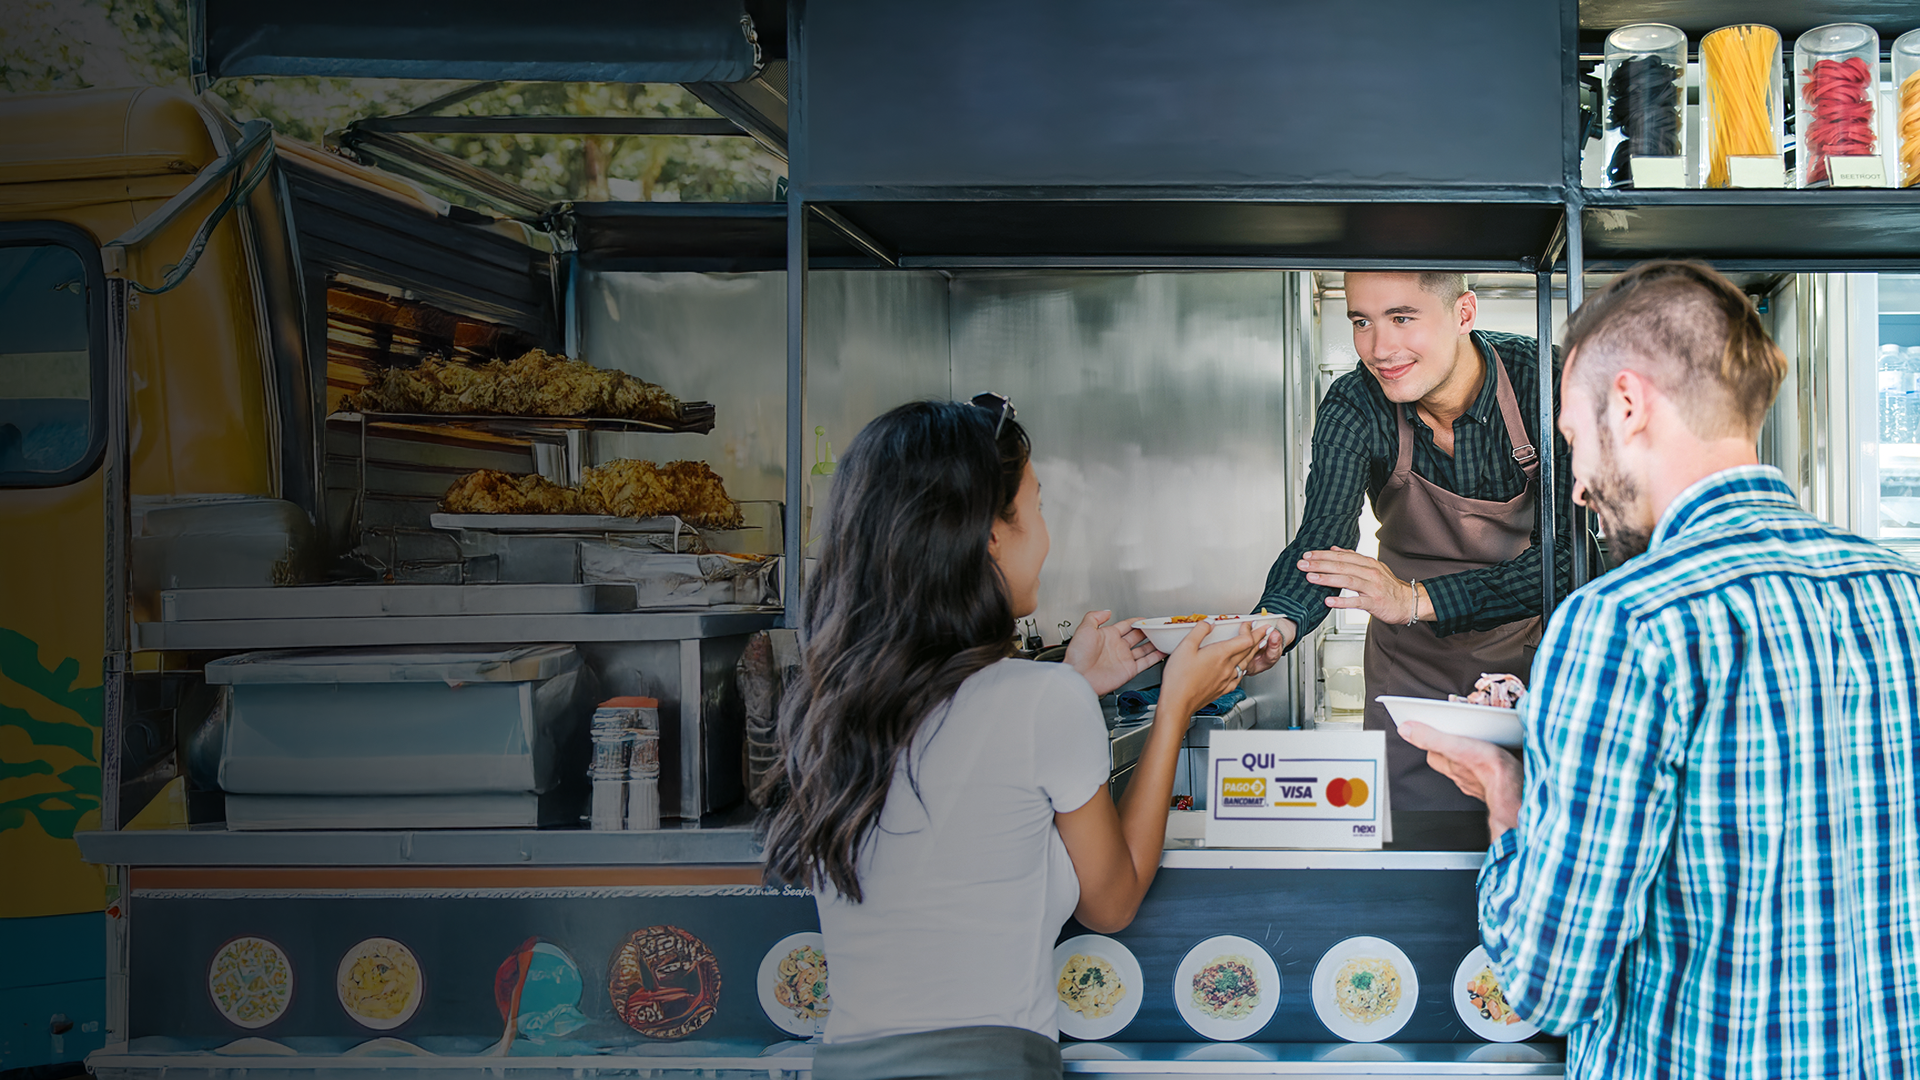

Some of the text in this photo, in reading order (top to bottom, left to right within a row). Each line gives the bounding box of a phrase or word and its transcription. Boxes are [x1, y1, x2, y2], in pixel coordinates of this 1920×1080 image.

[1241, 753, 1275, 772] QUI
[1224, 782, 1250, 792] PAGO
[1280, 786, 1313, 799] VISA
[1223, 797, 1265, 805] BANCOMAT
[1353, 825, 1376, 833] nexi
